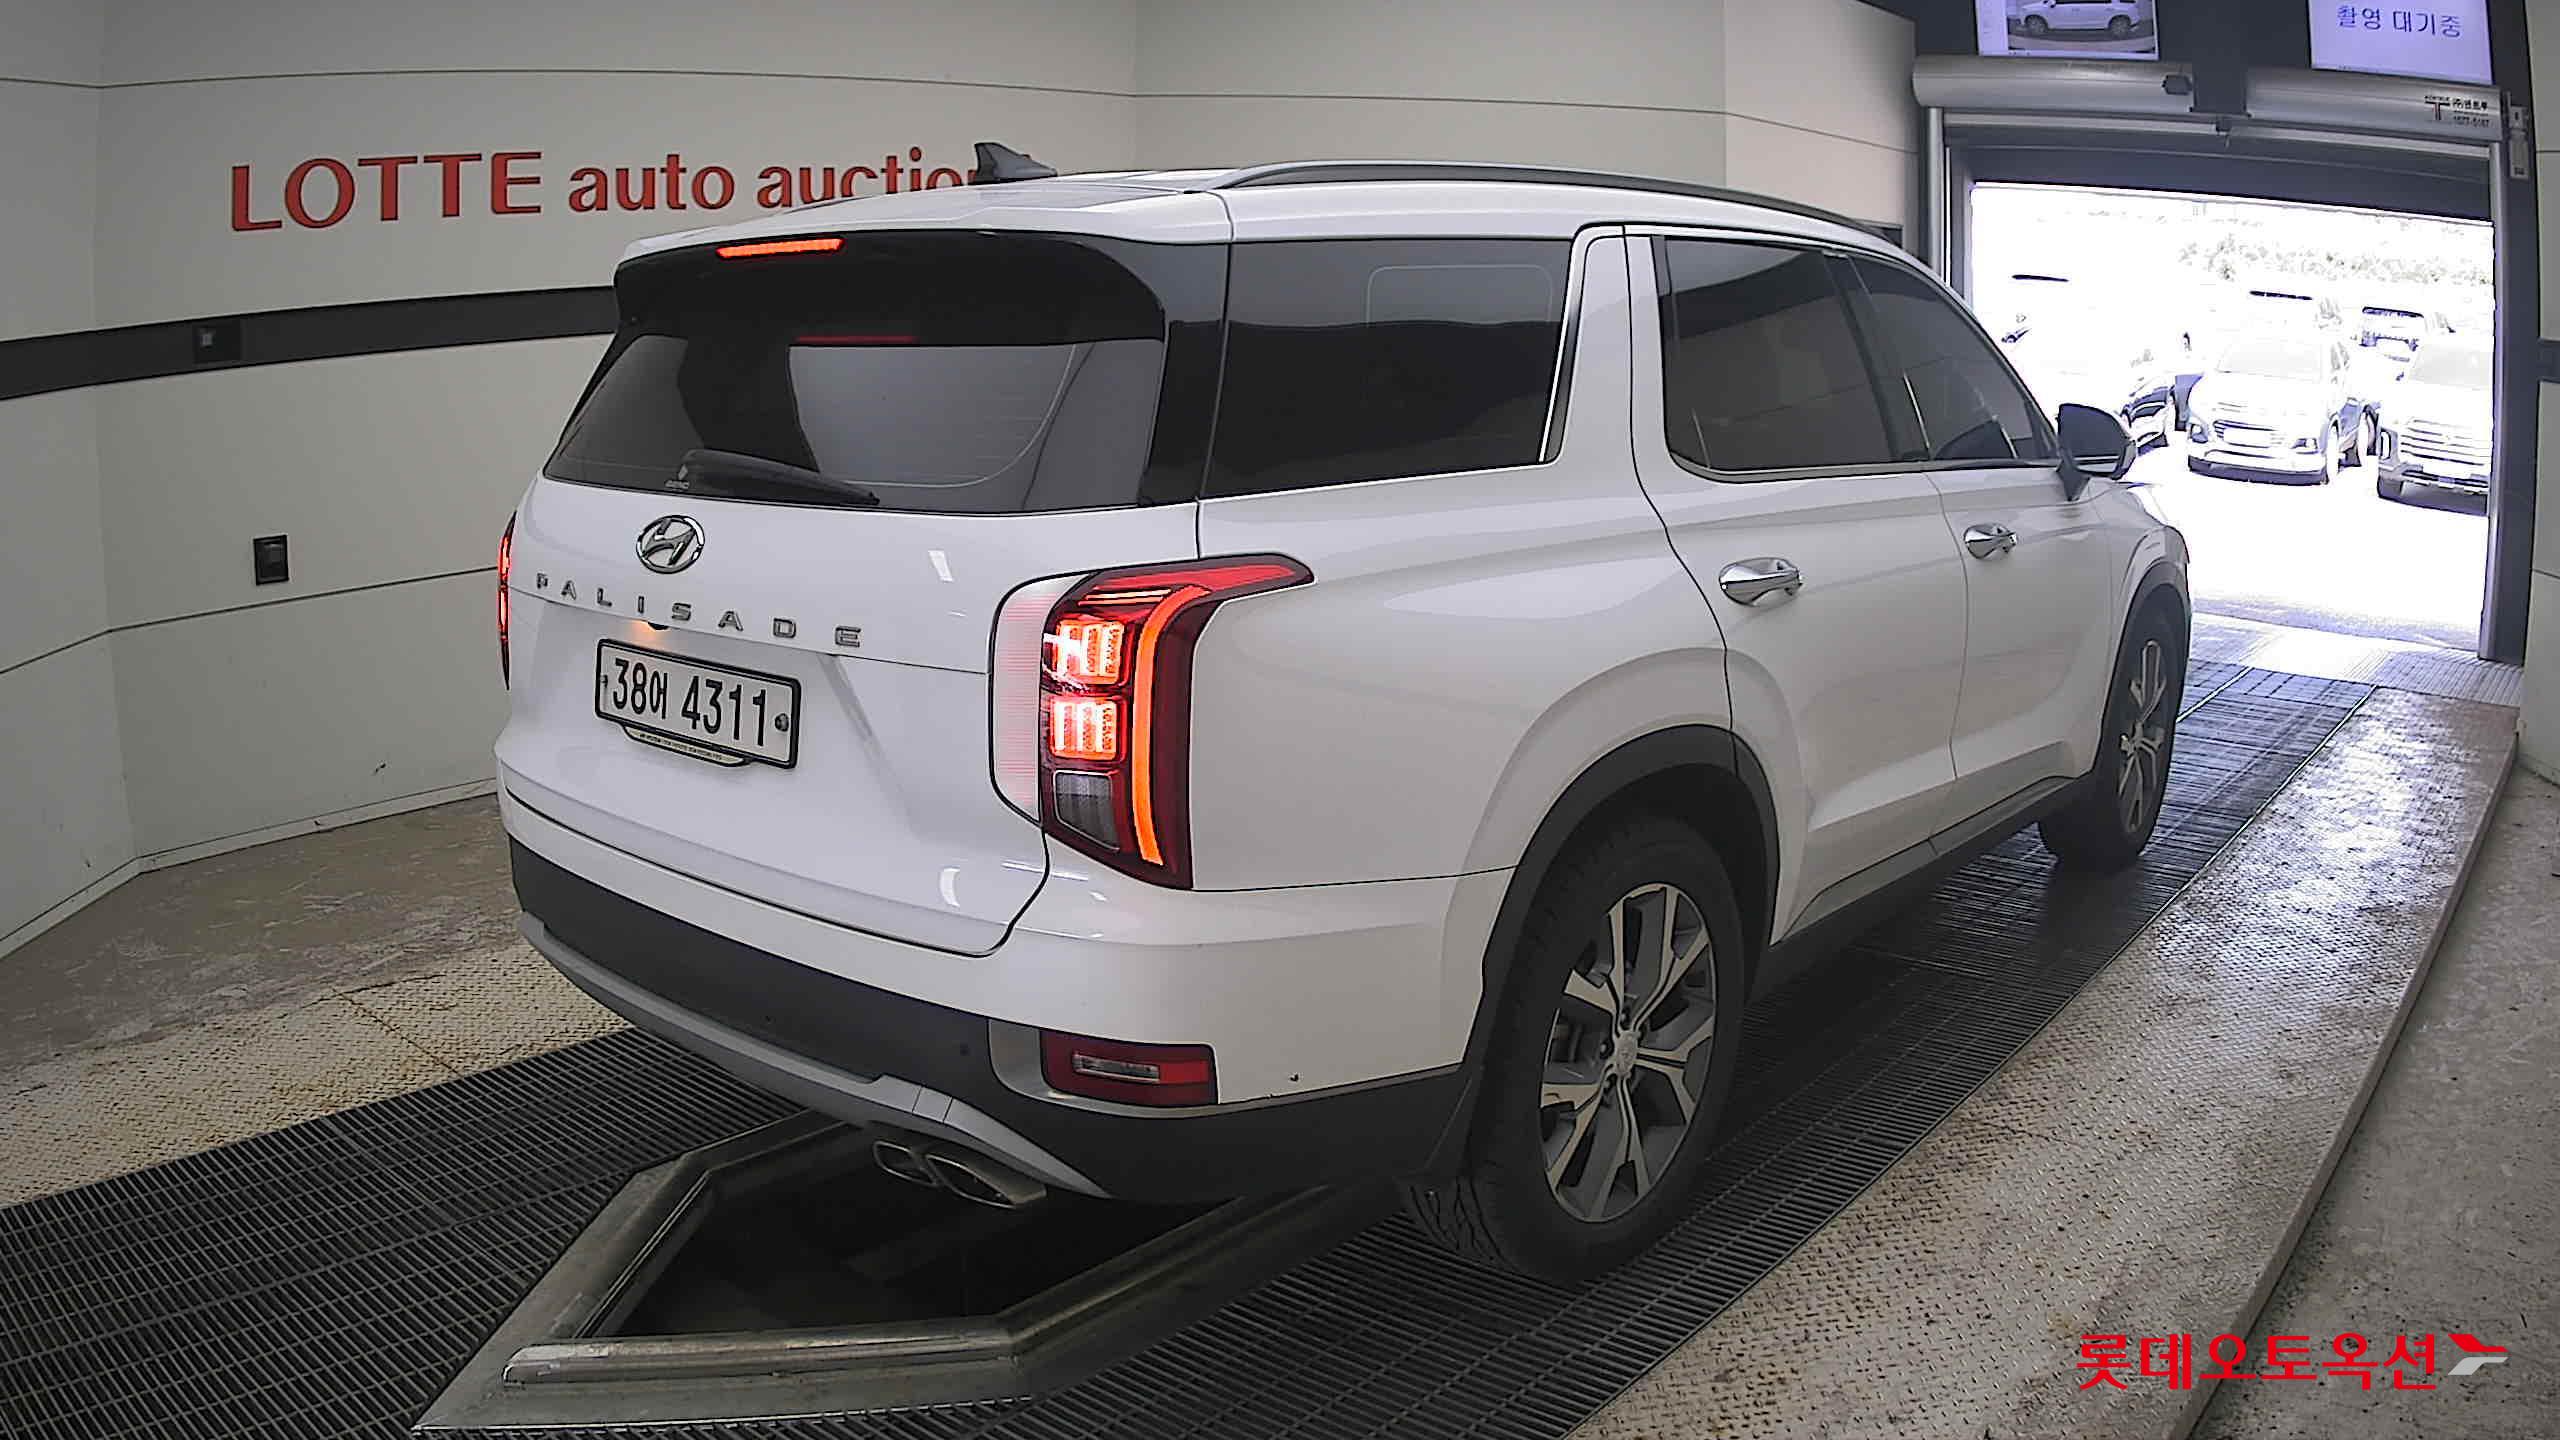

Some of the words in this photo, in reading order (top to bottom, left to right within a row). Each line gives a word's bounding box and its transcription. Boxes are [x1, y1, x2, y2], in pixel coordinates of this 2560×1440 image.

[2338, 5, 2381, 30] 촬영
[2393, 11, 2460, 38] 대기중
[231, 152, 542, 232] LOTTE
[568, 153, 735, 212] auto
[756, 146, 977, 208] auctio
[536, 572, 862, 648] PALISADE
[613, 657, 667, 720] 38어
[681, 675, 766, 747] 4311
